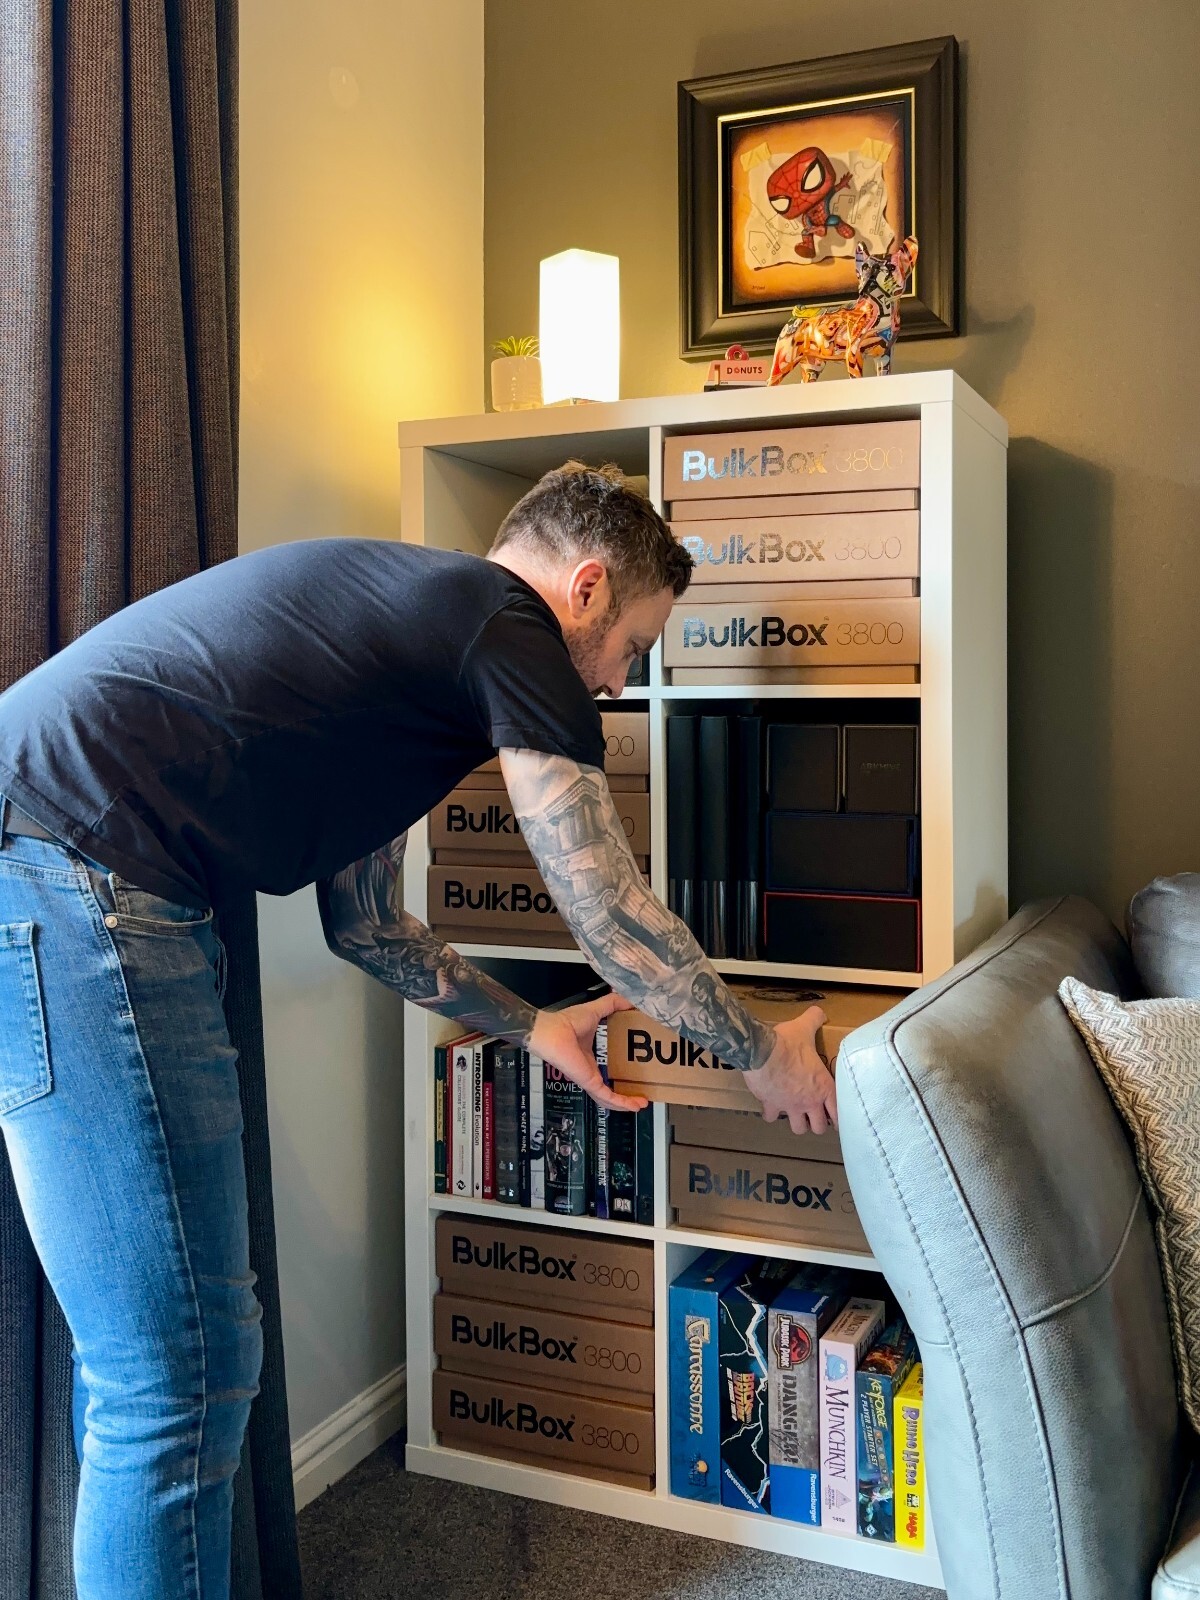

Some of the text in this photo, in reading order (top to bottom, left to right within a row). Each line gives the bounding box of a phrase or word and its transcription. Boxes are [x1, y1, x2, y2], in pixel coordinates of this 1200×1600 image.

[682, 446, 903, 482] BulkBox 3800
[682, 532, 902, 566] BulkBox 3800
[683, 616, 904, 648] BulkBox 3800
[606, 736, 635, 756] 00
[446, 804, 522, 834] Bulk
[596, 1024, 608, 1066] MARVEL
[546, 1081, 583, 1092] MOVIES
[615, 1198, 630, 1209] DK
[689, 1162, 832, 1212] BulkBox
[452, 1236, 640, 1291] BulkBox 3800
[451, 1315, 641, 1374] BulkBox 3800
[780, 1317, 791, 1368] JURASSIC PARK
[686, 1318, 710, 1435] Carcassonne
[742, 1373, 754, 1421] BACK
[450, 1390, 639, 1454] BulkBox 3800
[734, 1381, 744, 1422] FUTURE
[782, 1374, 798, 1464] DANGER!
[870, 1377, 888, 1430] KEYFORGE
[824, 1385, 850, 1480] MUNCHKIN
[861, 1399, 871, 1424] PLAYER
[866, 1425, 876, 1453] STARTER
[902, 1406, 920, 1450] RHINO
[724, 1468, 760, 1509] Ravensburger
[902, 1450, 920, 1486] HERO
[906, 1511, 918, 1539] HABA
